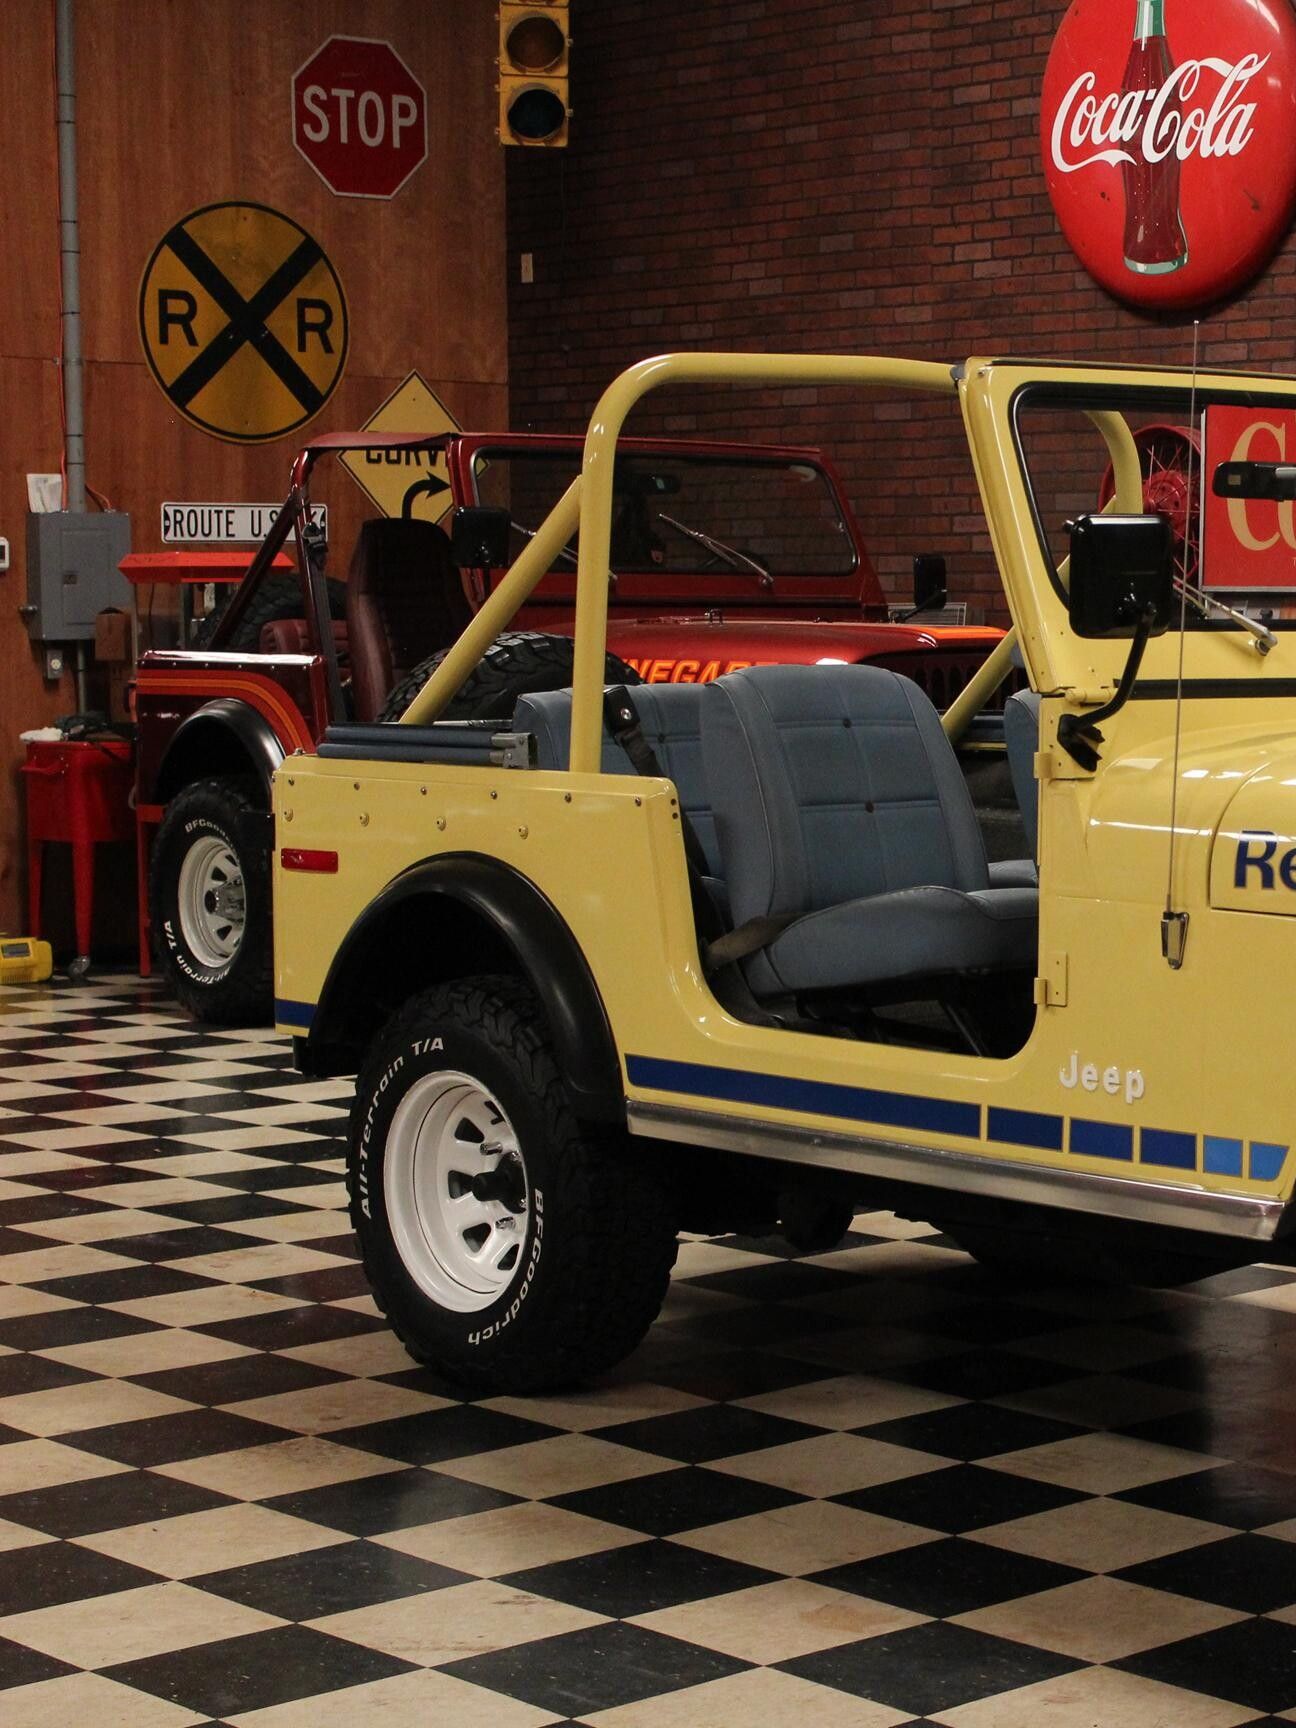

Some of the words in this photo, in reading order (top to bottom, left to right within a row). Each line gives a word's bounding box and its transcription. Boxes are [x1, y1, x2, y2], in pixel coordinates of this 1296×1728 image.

[303, 85, 417, 149] STOP
[1051, 51, 1272, 173] Coca-Cola
[158, 288, 199, 347] R
[296, 297, 334, 354] R
[365, 450, 447, 466] CURV
[173, 508, 235, 538] ROUTE
[1058, 1050, 1145, 1104] Jeep
[358, 1056, 404, 1219] All-Terrain
[411, 1037, 444, 1057] T/A
[467, 1188, 545, 1345] BFGoodrich
